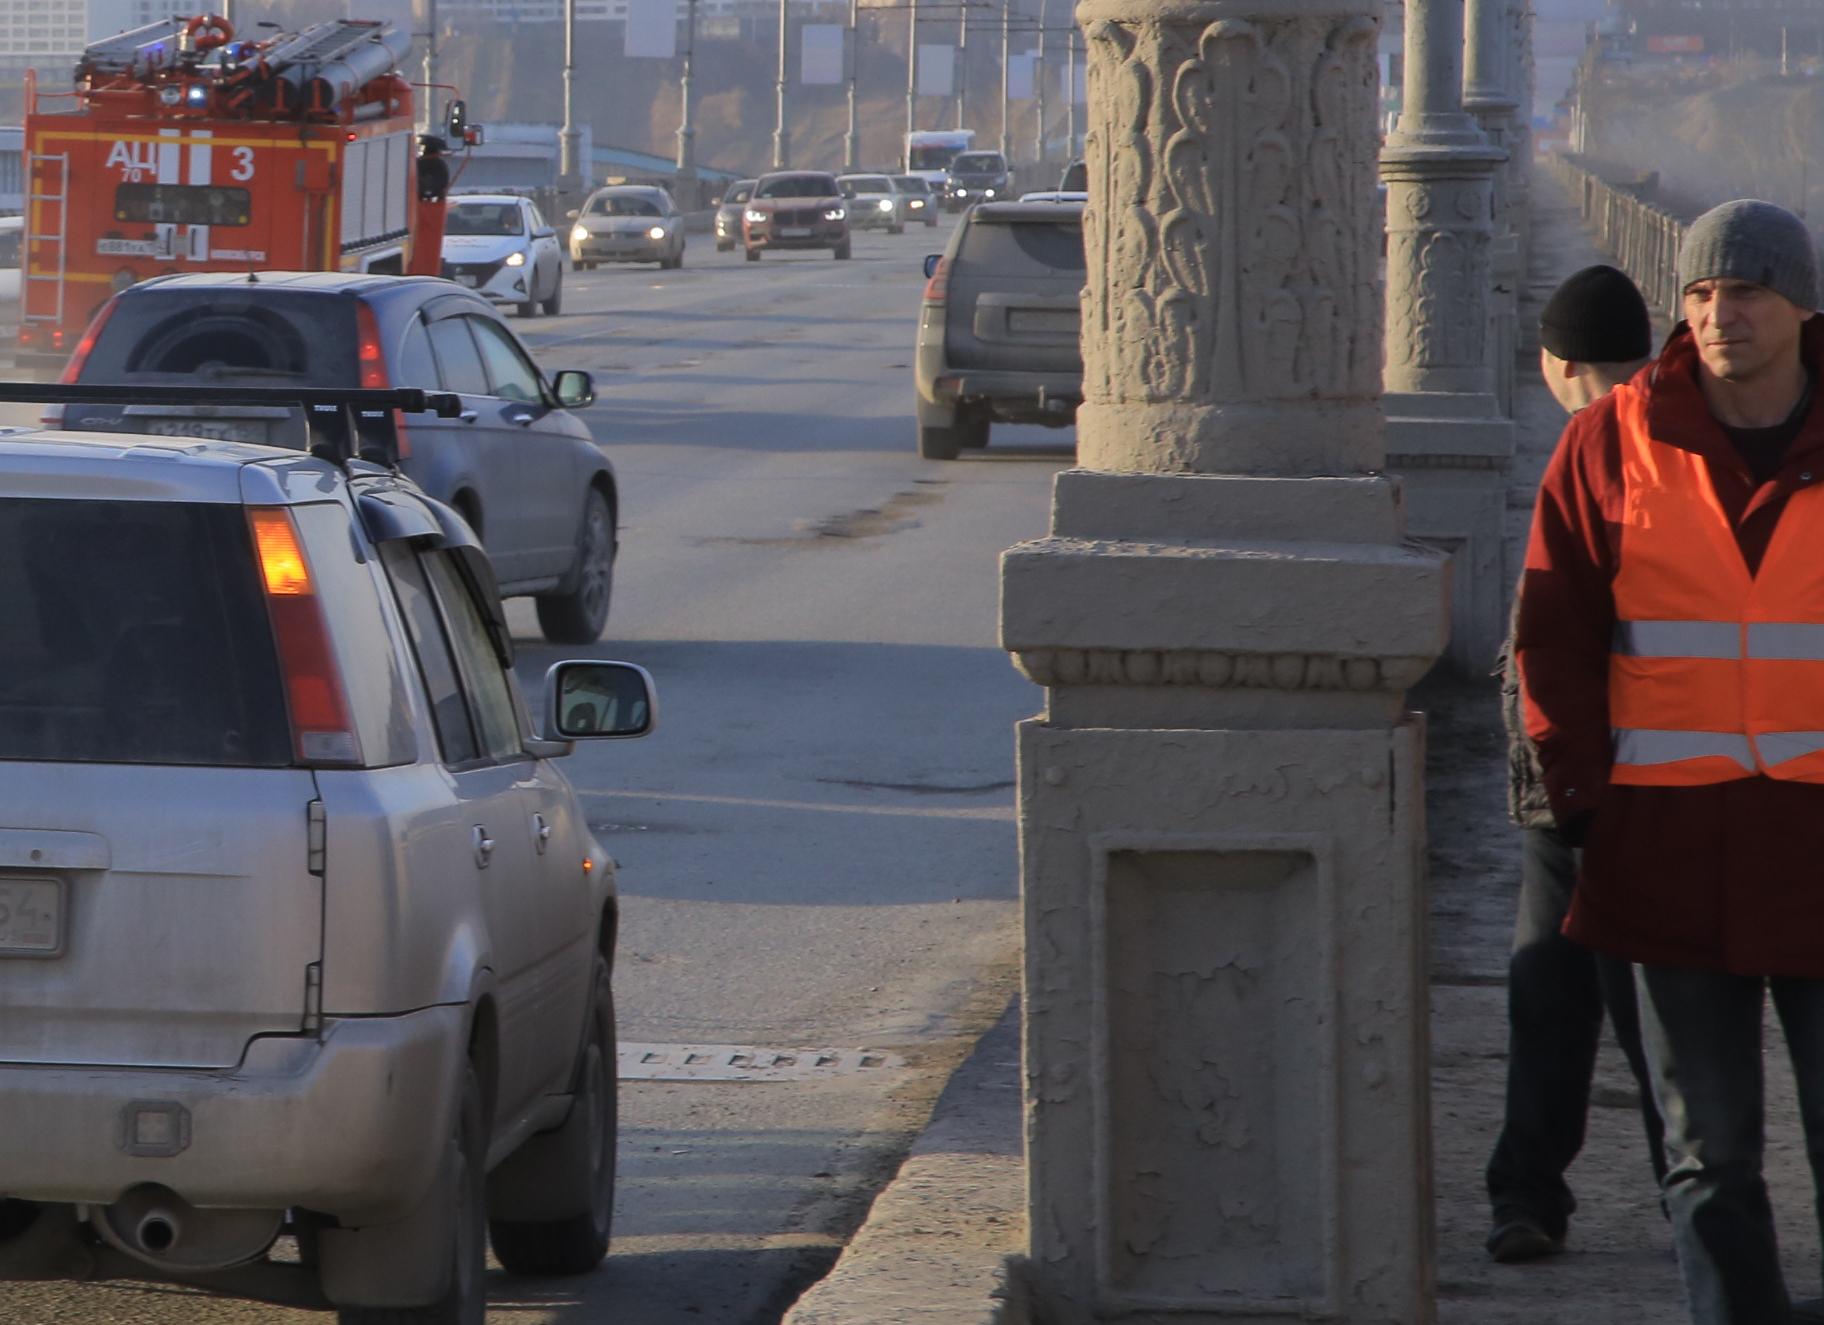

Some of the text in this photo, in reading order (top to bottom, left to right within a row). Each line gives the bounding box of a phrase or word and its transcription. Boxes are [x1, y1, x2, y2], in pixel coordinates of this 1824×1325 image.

[105, 139, 256, 182] АЦ 3
[120, 167, 143, 183] 70
